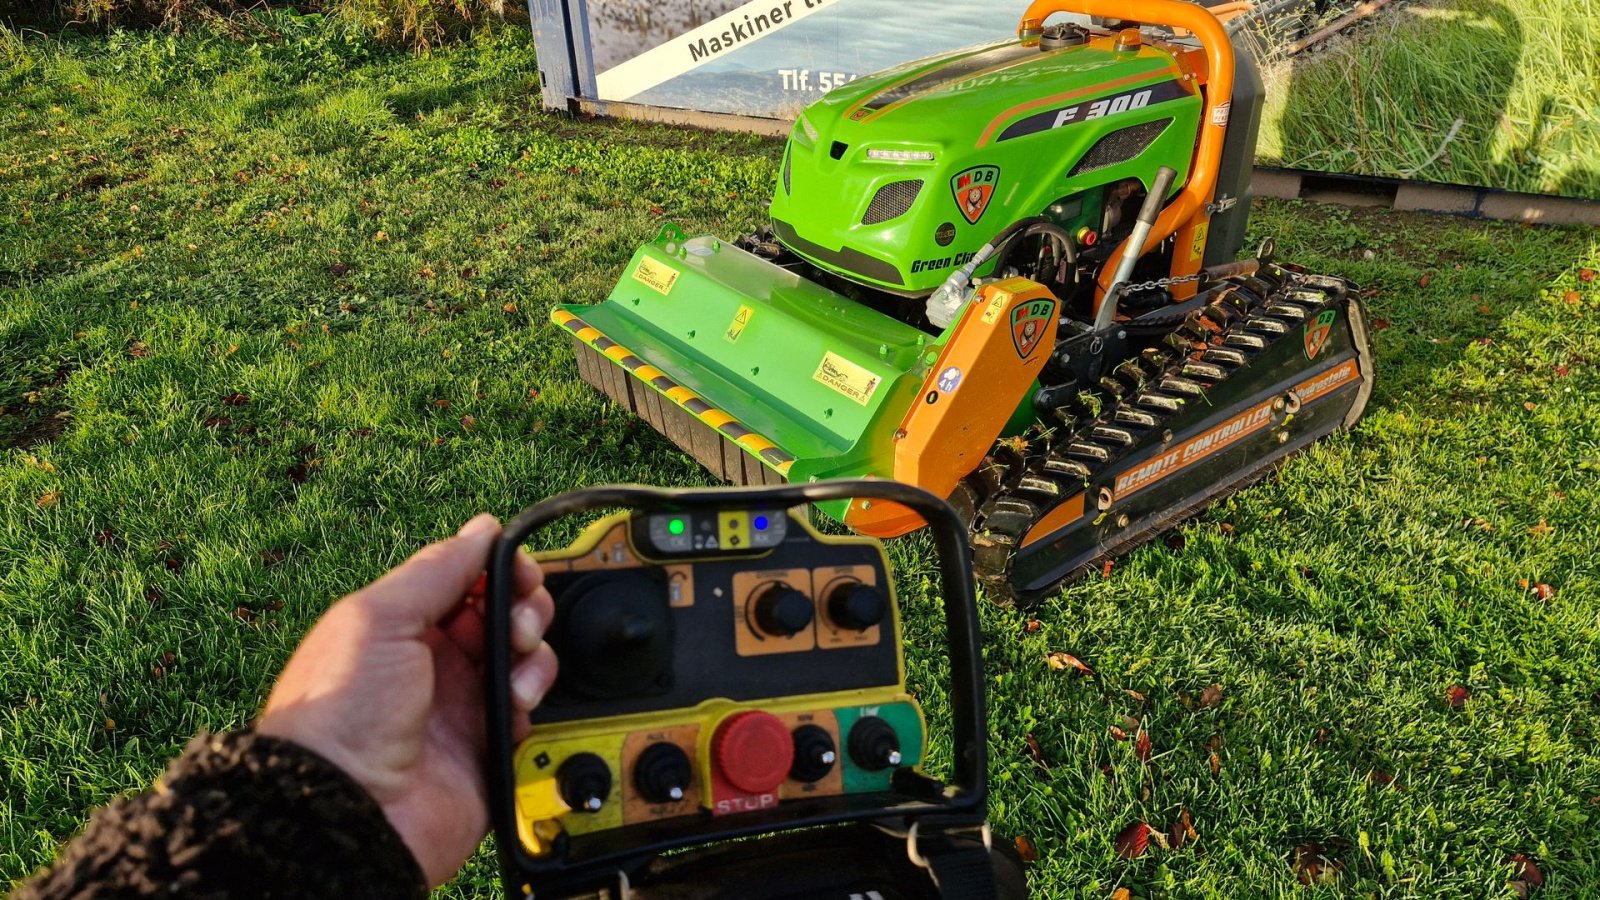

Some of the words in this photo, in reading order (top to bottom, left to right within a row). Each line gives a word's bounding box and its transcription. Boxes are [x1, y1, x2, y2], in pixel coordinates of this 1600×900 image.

[688, 1, 793, 62] Maskiner
[778, 69, 813, 91] Tlf.
[1052, 107, 1079, 129] F
[1085, 90, 1153, 120] 300
[911, 257, 951, 273] Green
[638, 273, 664, 290] DANGER
[822, 374, 861, 398] DANGER
[1115, 452, 1180, 495] REMOTE
[1182, 405, 1272, 463] CONTROLLED
[717, 794, 774, 813] STOP
